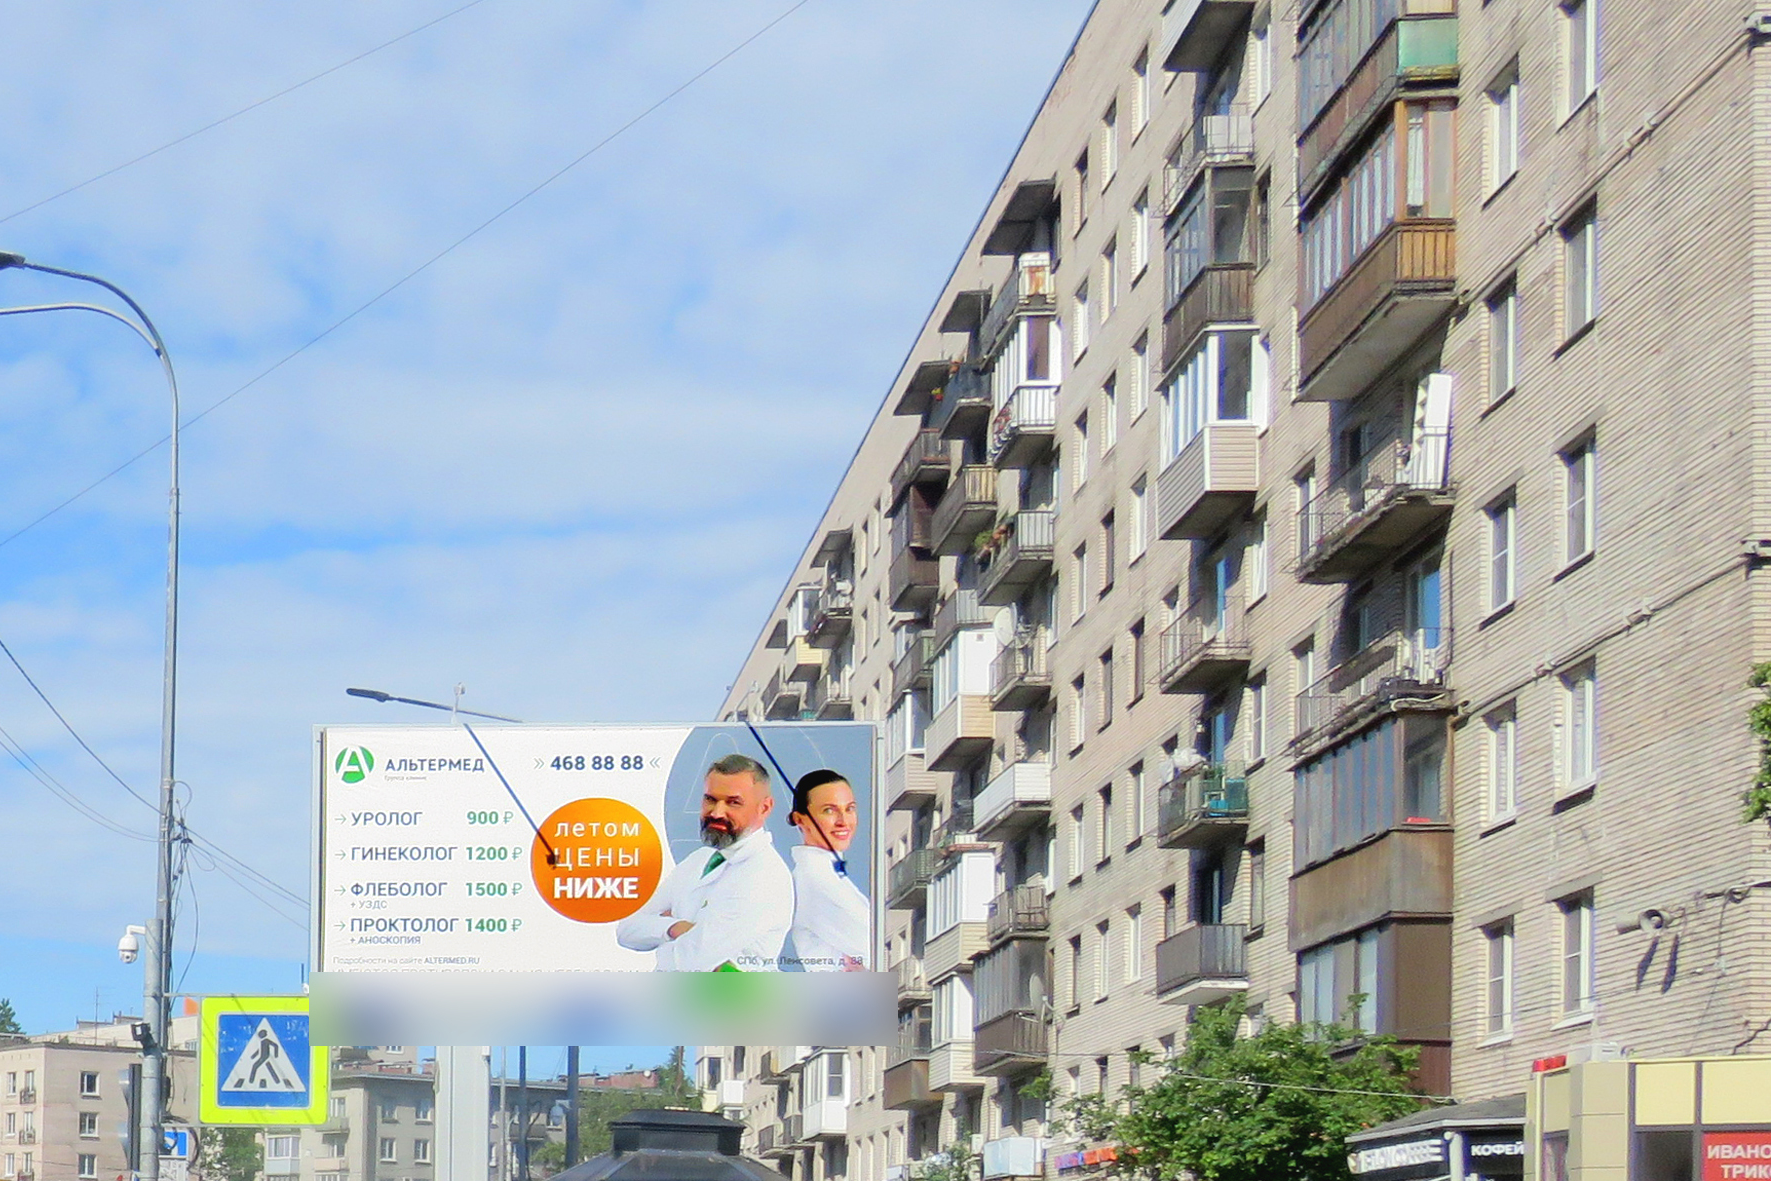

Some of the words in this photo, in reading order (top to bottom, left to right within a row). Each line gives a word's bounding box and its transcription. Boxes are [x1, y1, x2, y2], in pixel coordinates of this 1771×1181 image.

[385, 758, 485, 773] АЛЬТЕРМЕД
[550, 755, 586, 770] 468
[591, 755, 615, 770] 88
[620, 755, 644, 770] 88
[351, 812, 423, 826] УРОЛОГ
[467, 811, 499, 825] 900
[554, 822, 640, 837] летом
[351, 847, 458, 861] ГИНЕКОЛОГ
[466, 847, 508, 861] 1200
[553, 847, 640, 871] ЦЕНЫ
[350, 882, 448, 897] ФЛЕБОЛОГ
[466, 882, 508, 896] 1500
[553, 877, 639, 899] НИЖЕ
[359, 900, 388, 909] УЗДС
[350, 918, 459, 932] ПРОКТОЛОГ
[465, 918, 508, 932] 1400
[358, 936, 421, 945] АНОСКОПИЯ
[333, 956, 386, 965] Подробности
[1721, 1164, 1771, 1179] ТРИК
